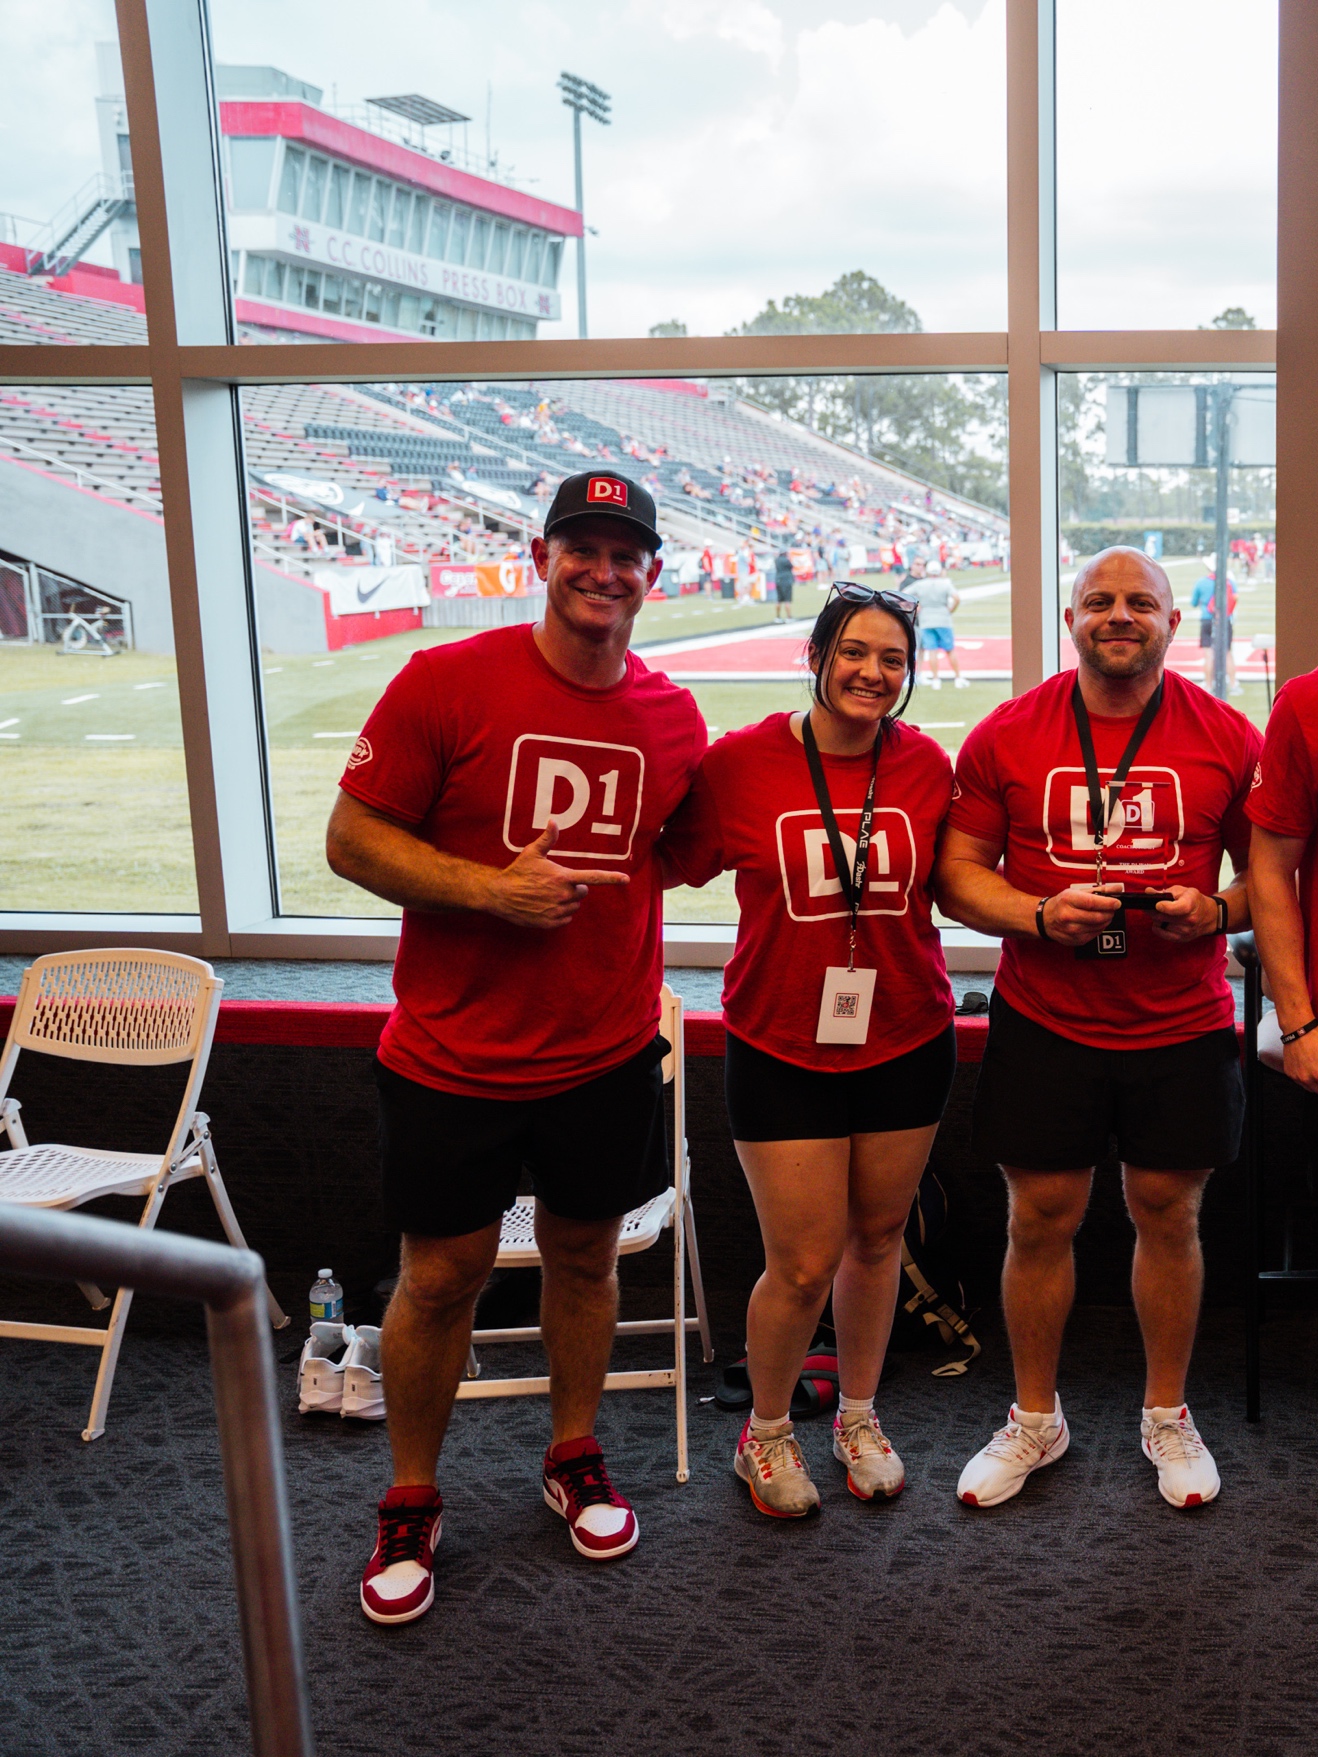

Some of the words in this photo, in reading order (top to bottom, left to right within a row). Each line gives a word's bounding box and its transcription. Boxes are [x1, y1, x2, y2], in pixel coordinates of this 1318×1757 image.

[361, 245, 429, 287] COLLINS
[442, 268, 489, 302] PRESS
[497, 281, 528, 310] BOX
[594, 481, 623, 502] D1
[532, 756, 623, 837] D1
[859, 811, 872, 849] PLAE
[803, 828, 900, 898] D1
[1102, 934, 1122, 950] D1
